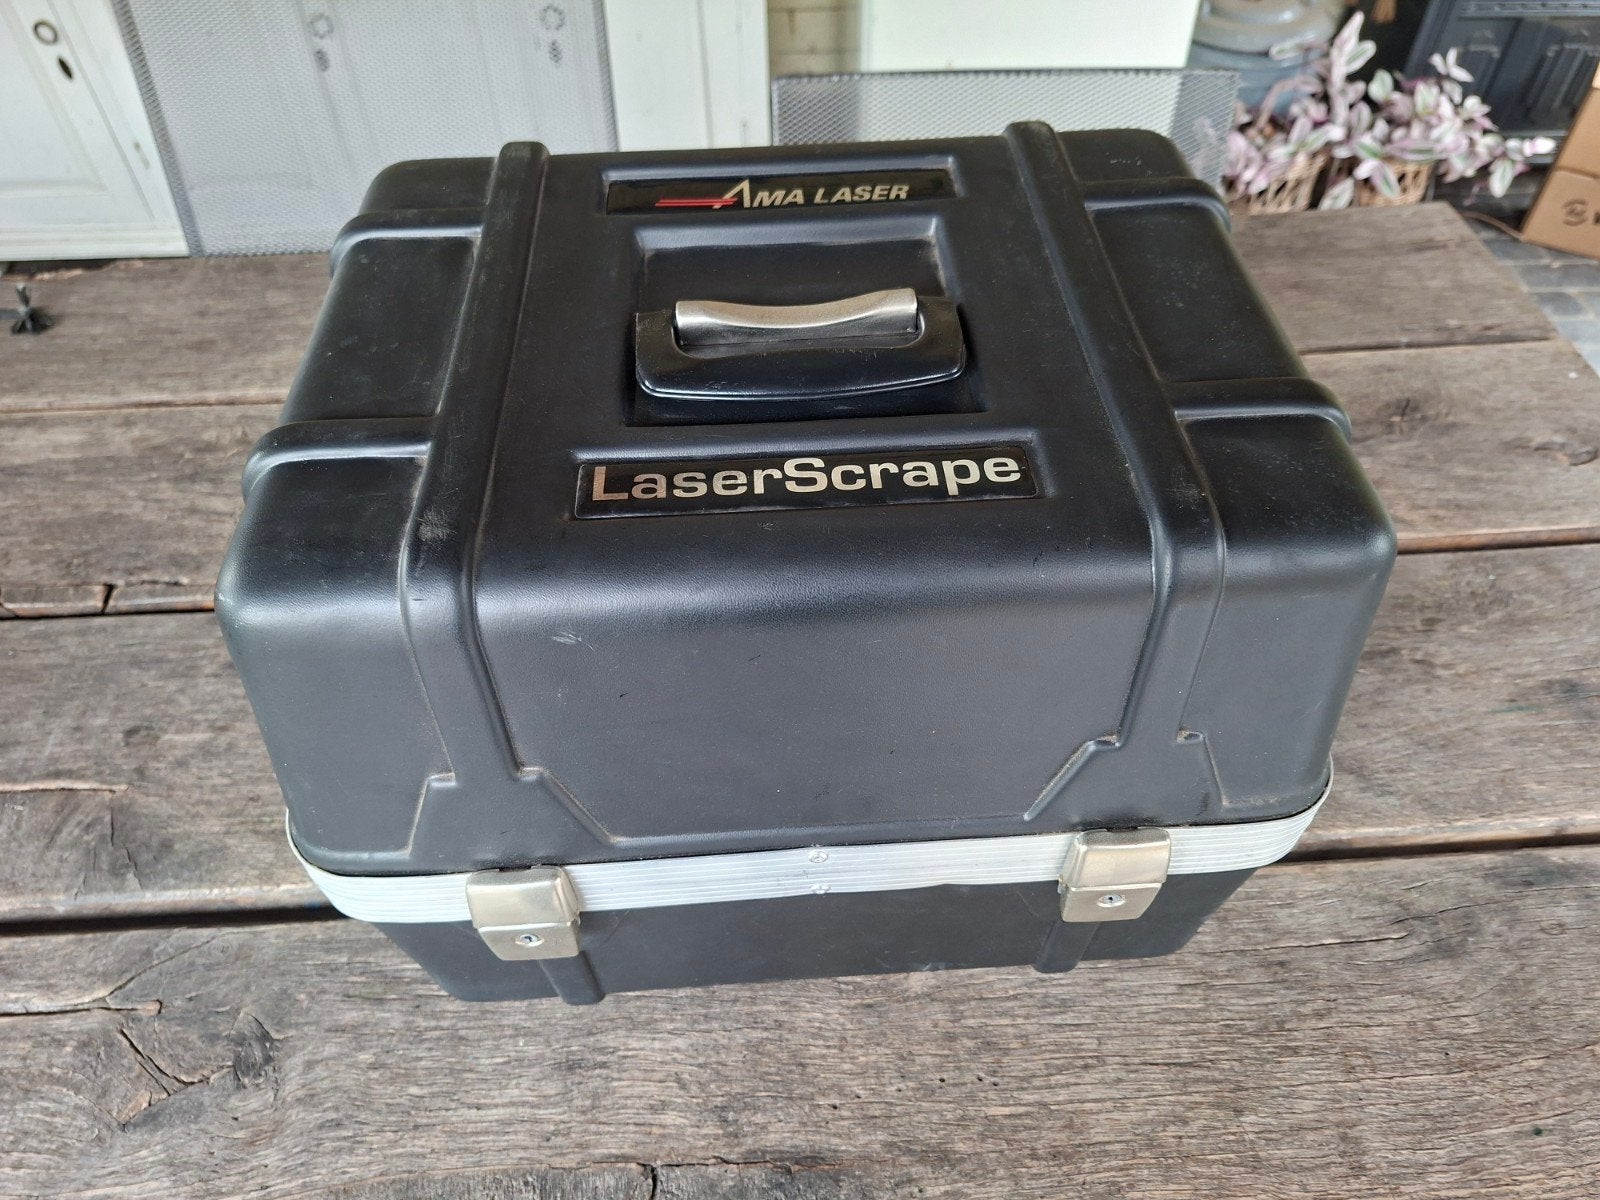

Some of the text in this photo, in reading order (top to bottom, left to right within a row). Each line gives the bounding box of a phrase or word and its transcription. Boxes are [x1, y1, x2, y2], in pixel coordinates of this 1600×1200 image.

[713, 180, 910, 209] AMA LASER
[592, 457, 1022, 502] LaserScrape
